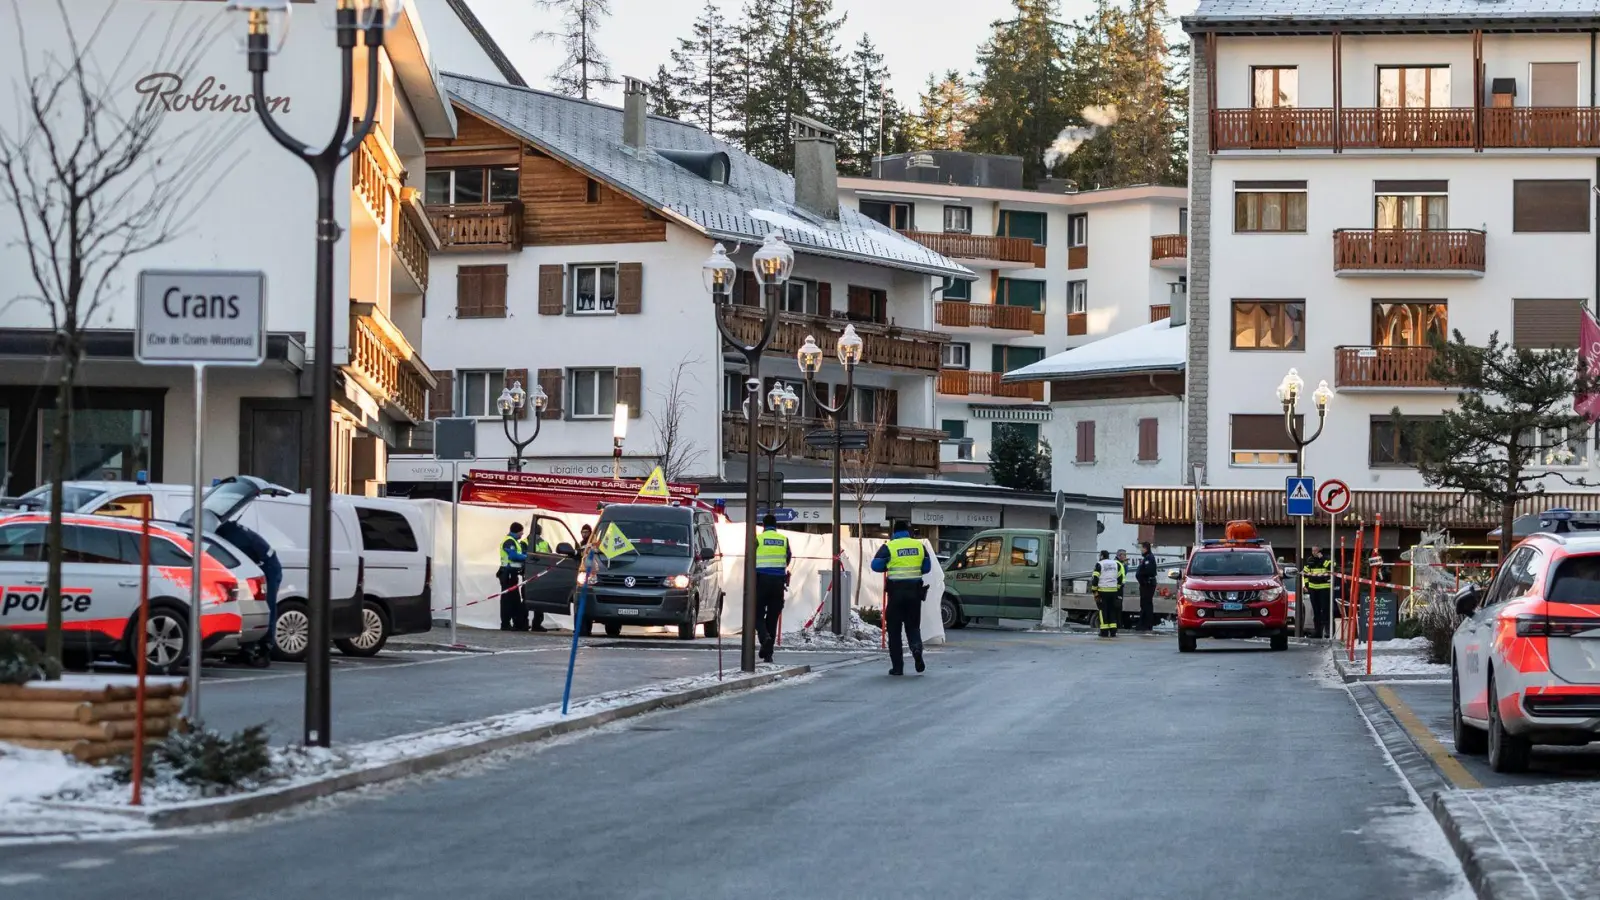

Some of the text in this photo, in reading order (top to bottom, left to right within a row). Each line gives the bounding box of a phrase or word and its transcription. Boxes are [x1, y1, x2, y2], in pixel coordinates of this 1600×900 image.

[163, 286, 240, 319] Crans
[169, 333, 180, 345] de
[587, 465, 598, 473] de
[602, 465, 628, 473] Crns
[475, 472, 505, 480] POSTE
[521, 475, 600, 488] COMMANDEMENT
[602, 481, 642, 490] SAPEURS
[794, 511, 820, 519] RES
[898, 548, 918, 556] POLICE
[2, 587, 92, 616] polce
